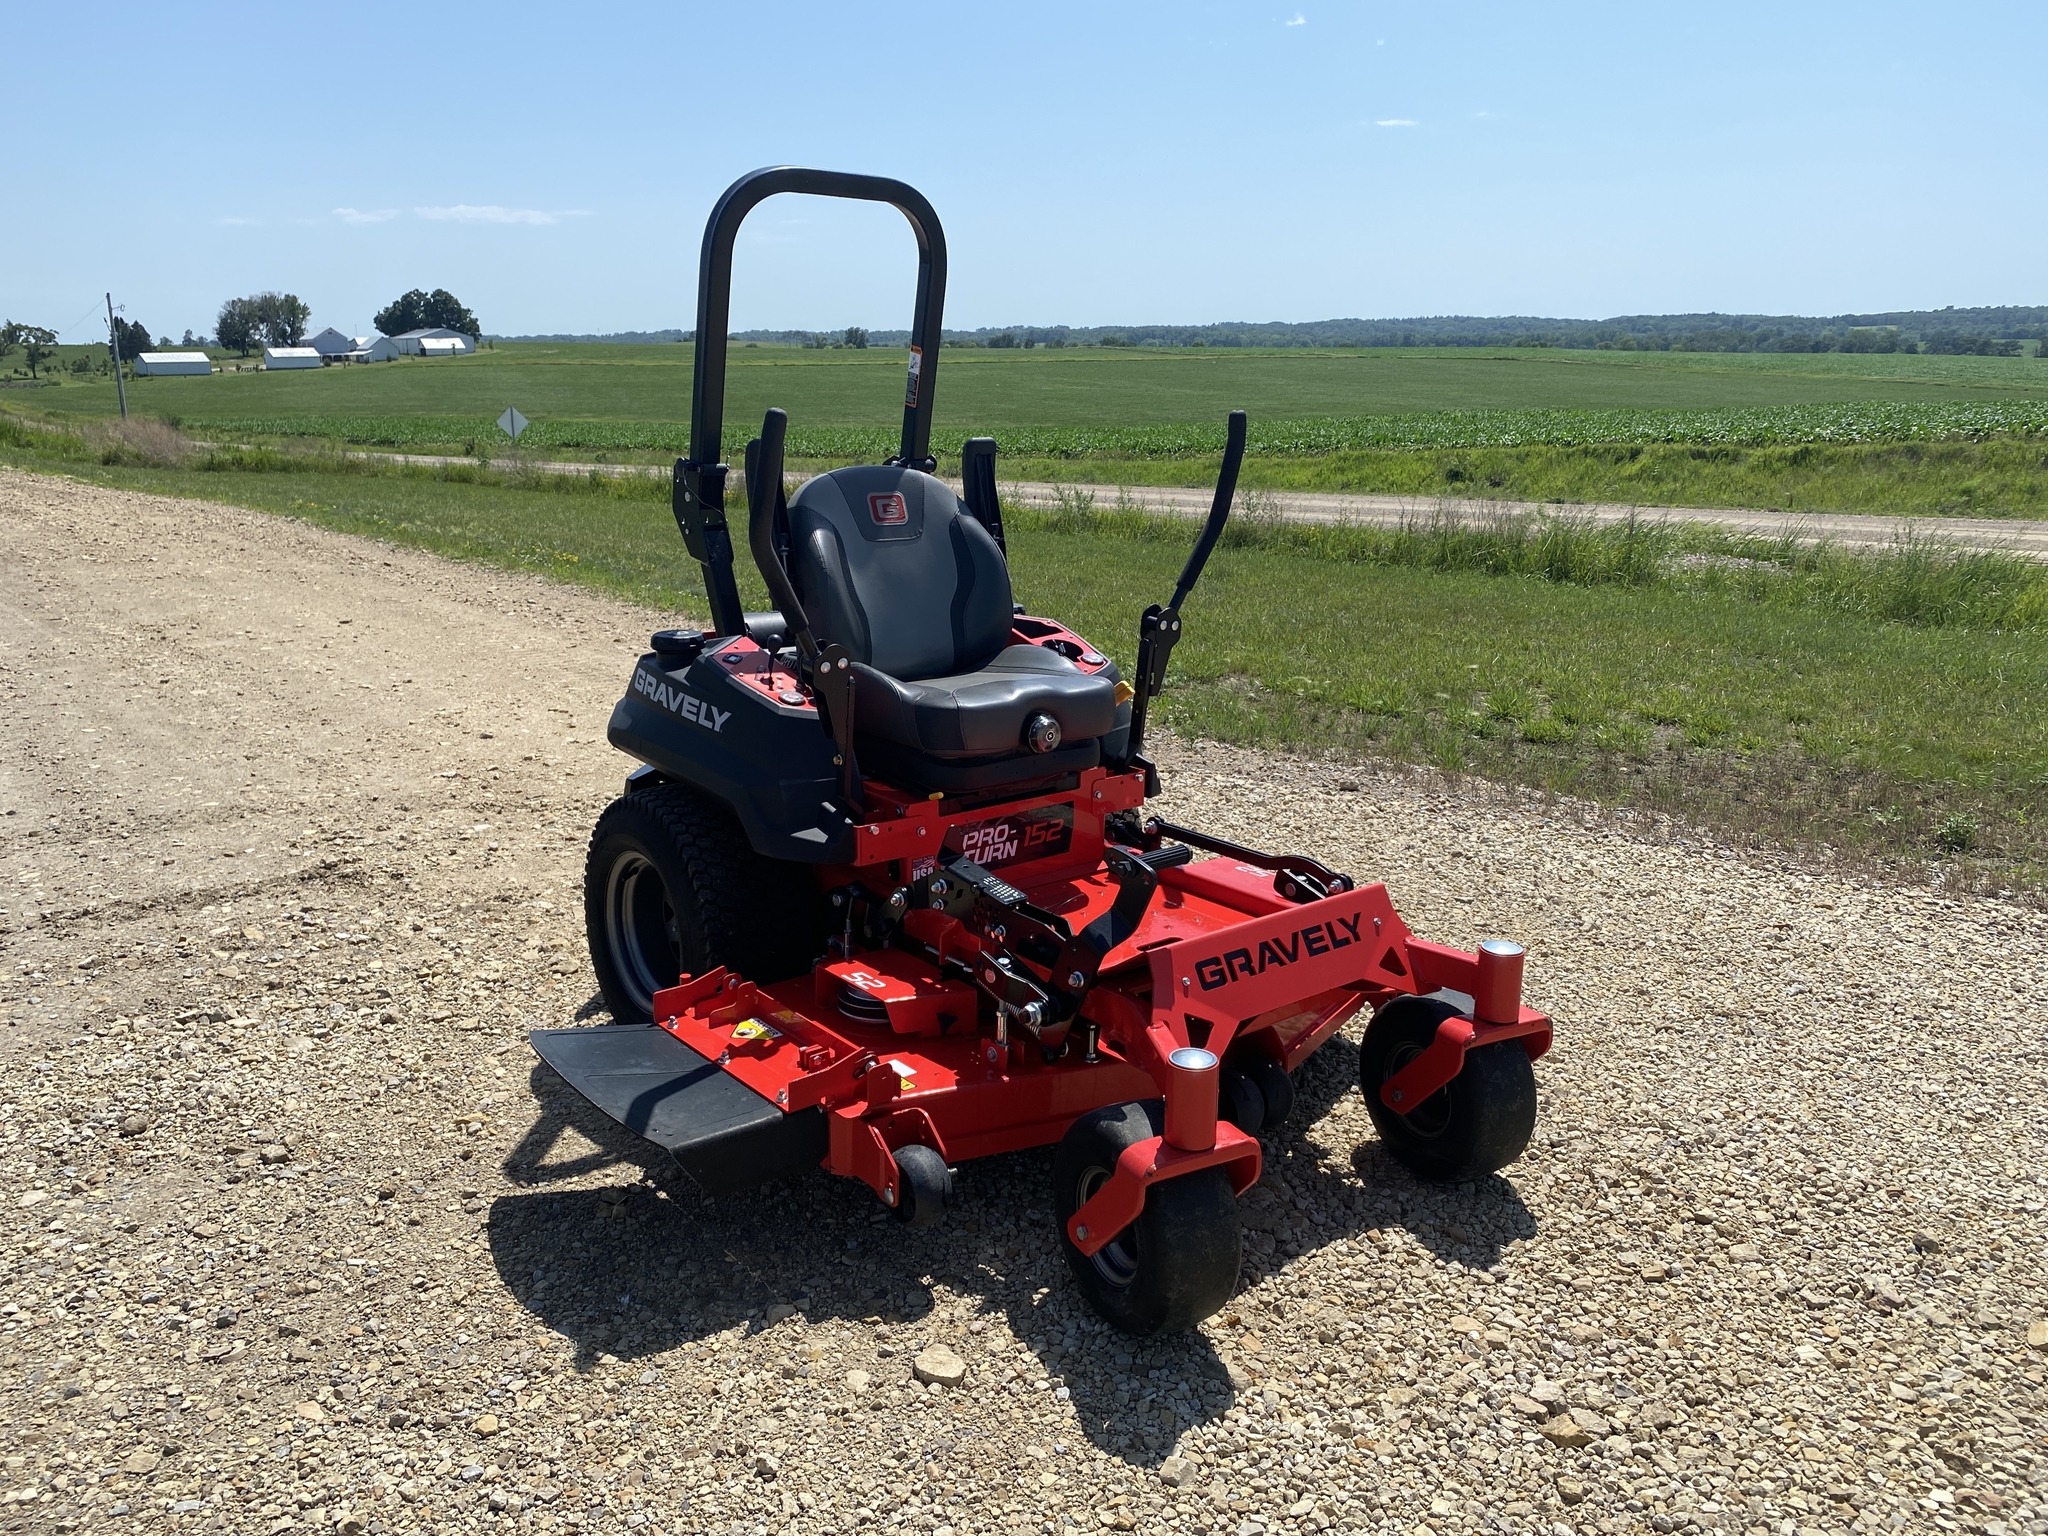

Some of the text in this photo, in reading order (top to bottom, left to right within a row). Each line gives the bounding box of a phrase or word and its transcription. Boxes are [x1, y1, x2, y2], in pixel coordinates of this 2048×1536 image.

[634, 667, 732, 732] GRAVELY
[962, 824, 1017, 850] PRO-
[1023, 818, 1064, 847] 152
[1195, 912, 1361, 991] GRAVELY
[840, 971, 887, 990] 52
